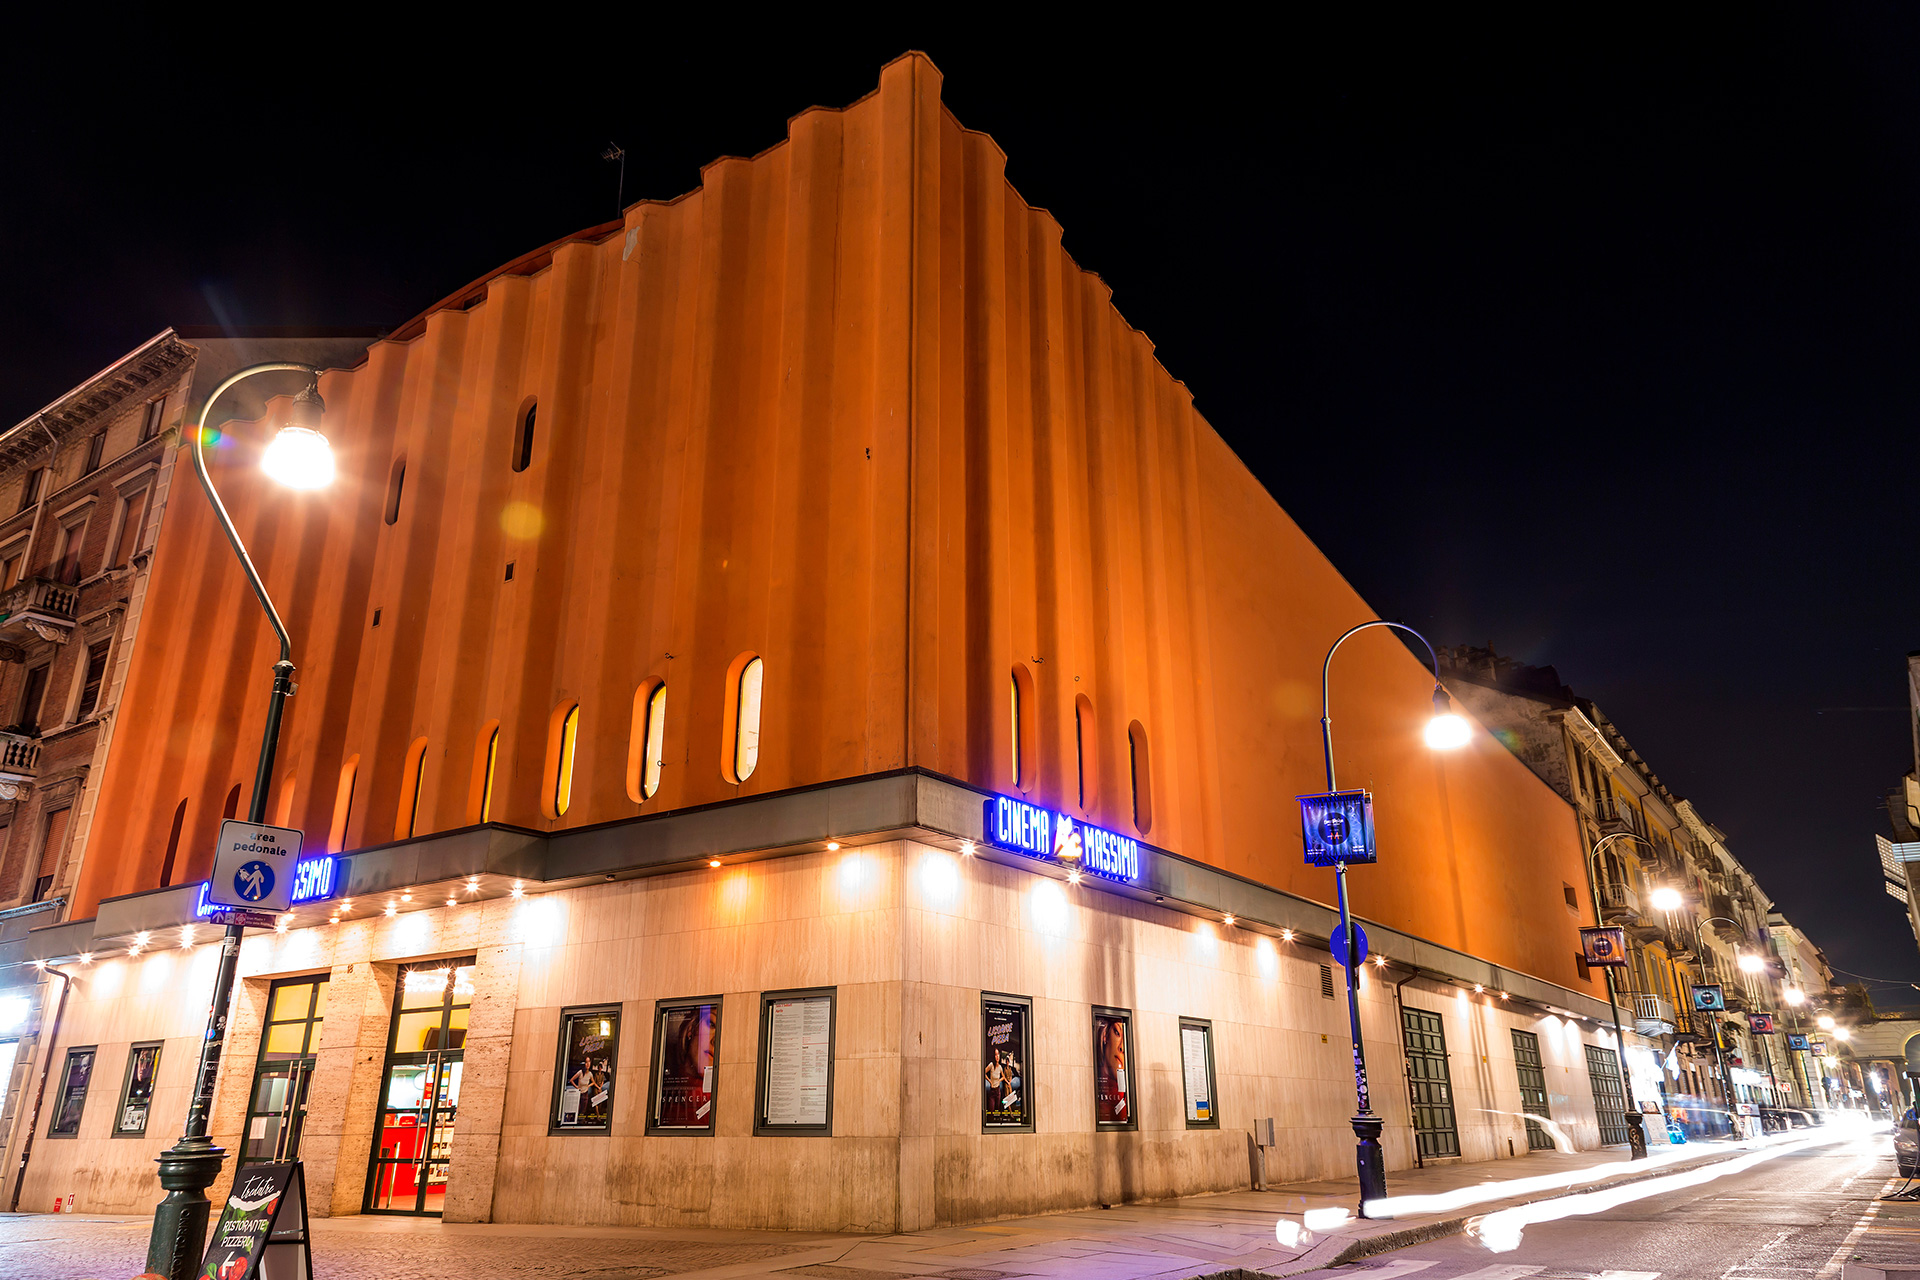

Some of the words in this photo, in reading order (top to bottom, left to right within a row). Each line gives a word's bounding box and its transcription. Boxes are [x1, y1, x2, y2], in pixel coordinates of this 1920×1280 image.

[250, 832, 275, 843] area
[998, 796, 1050, 854] CINEMA
[1084, 825, 1139, 880] MASSIMO
[233, 842, 287, 857] pedonale
[582, 1040, 605, 1055] PIZZA
[662, 1095, 707, 1103] SPENCER
[222, 1219, 268, 1232] RISTORANTE
[221, 1236, 255, 1248] PIZZERIA
